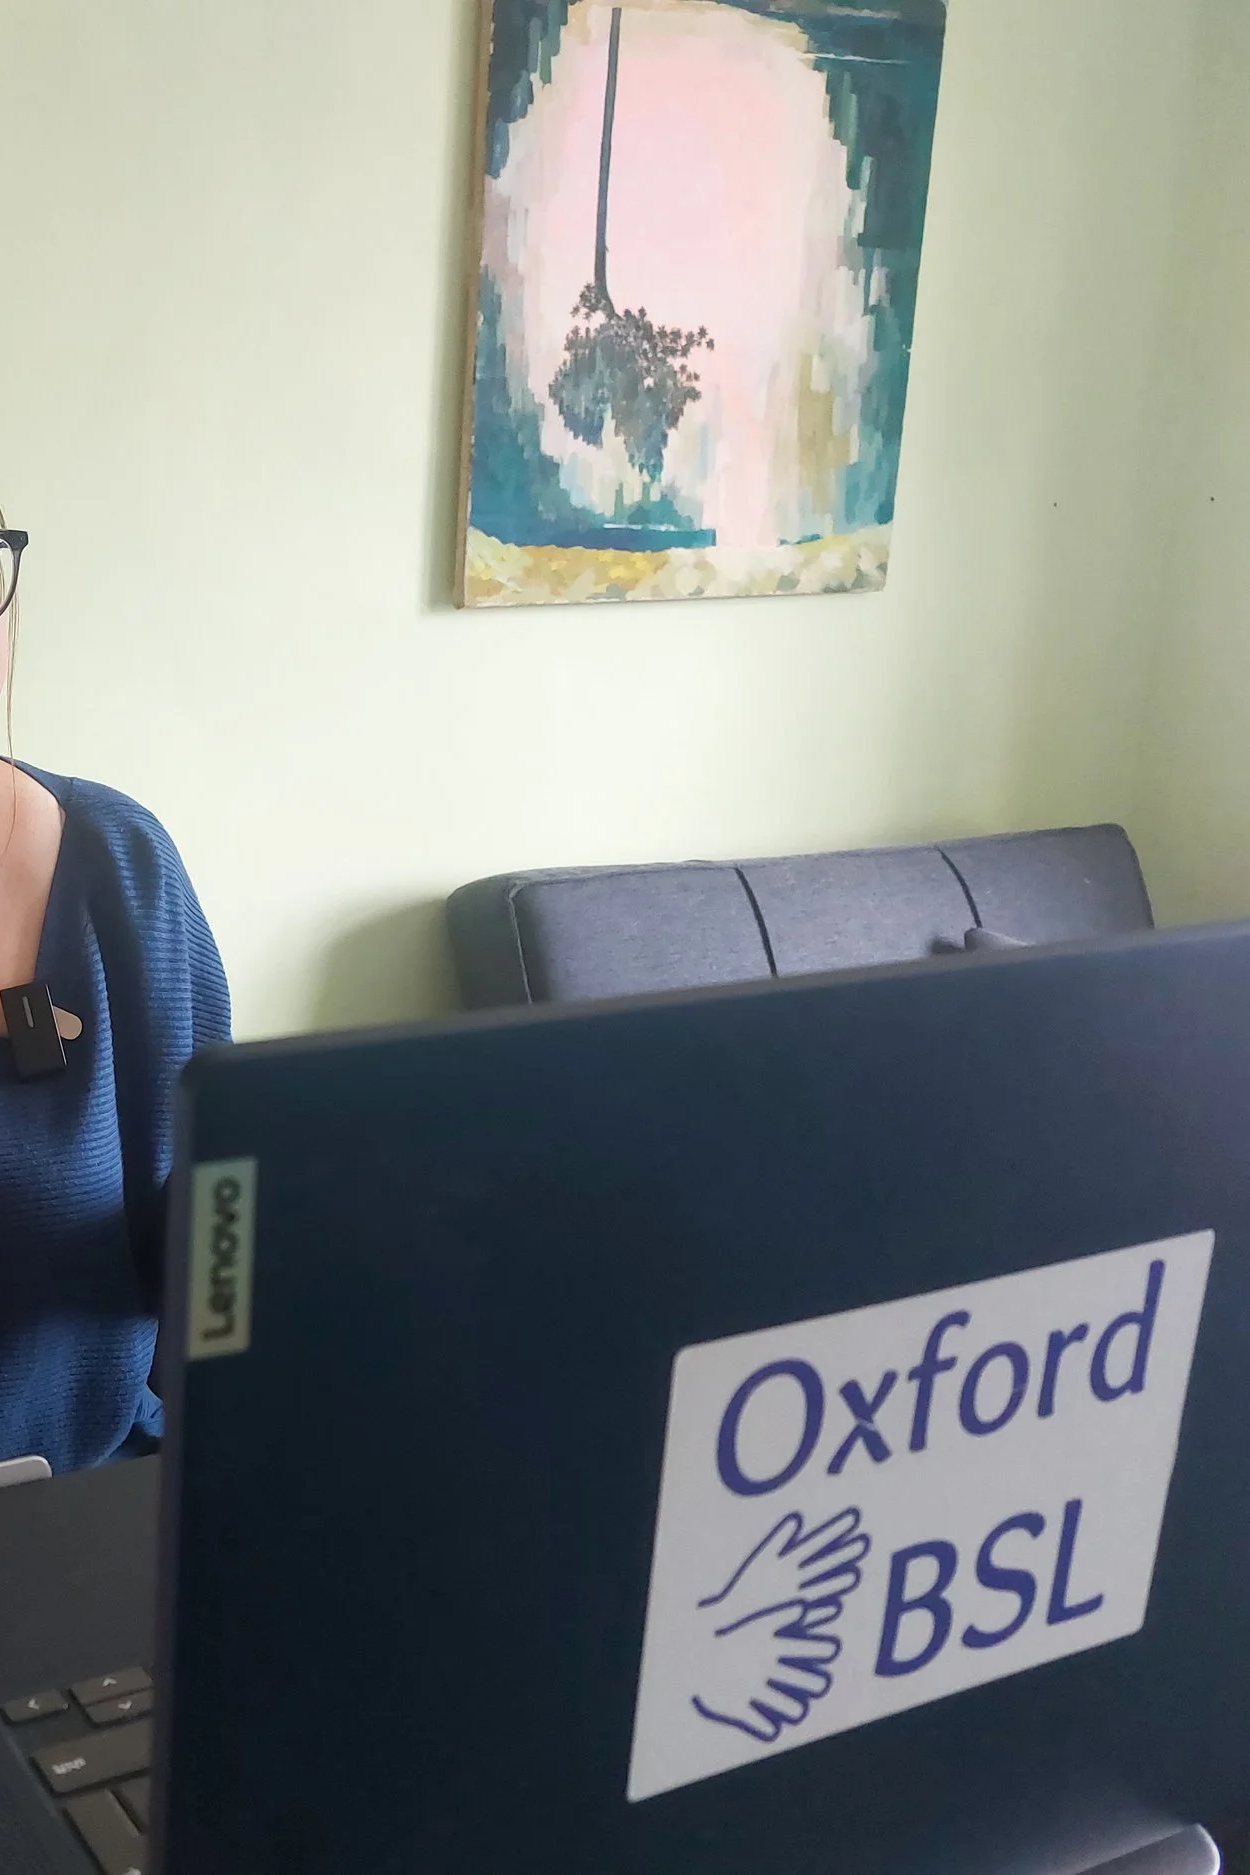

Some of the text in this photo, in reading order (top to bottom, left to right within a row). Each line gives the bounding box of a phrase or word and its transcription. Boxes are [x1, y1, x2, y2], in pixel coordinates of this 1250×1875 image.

[201, 1176, 241, 1342] Lenovo
[716, 1259, 1166, 1497] Oxford
[875, 1499, 1104, 1677] BSL
